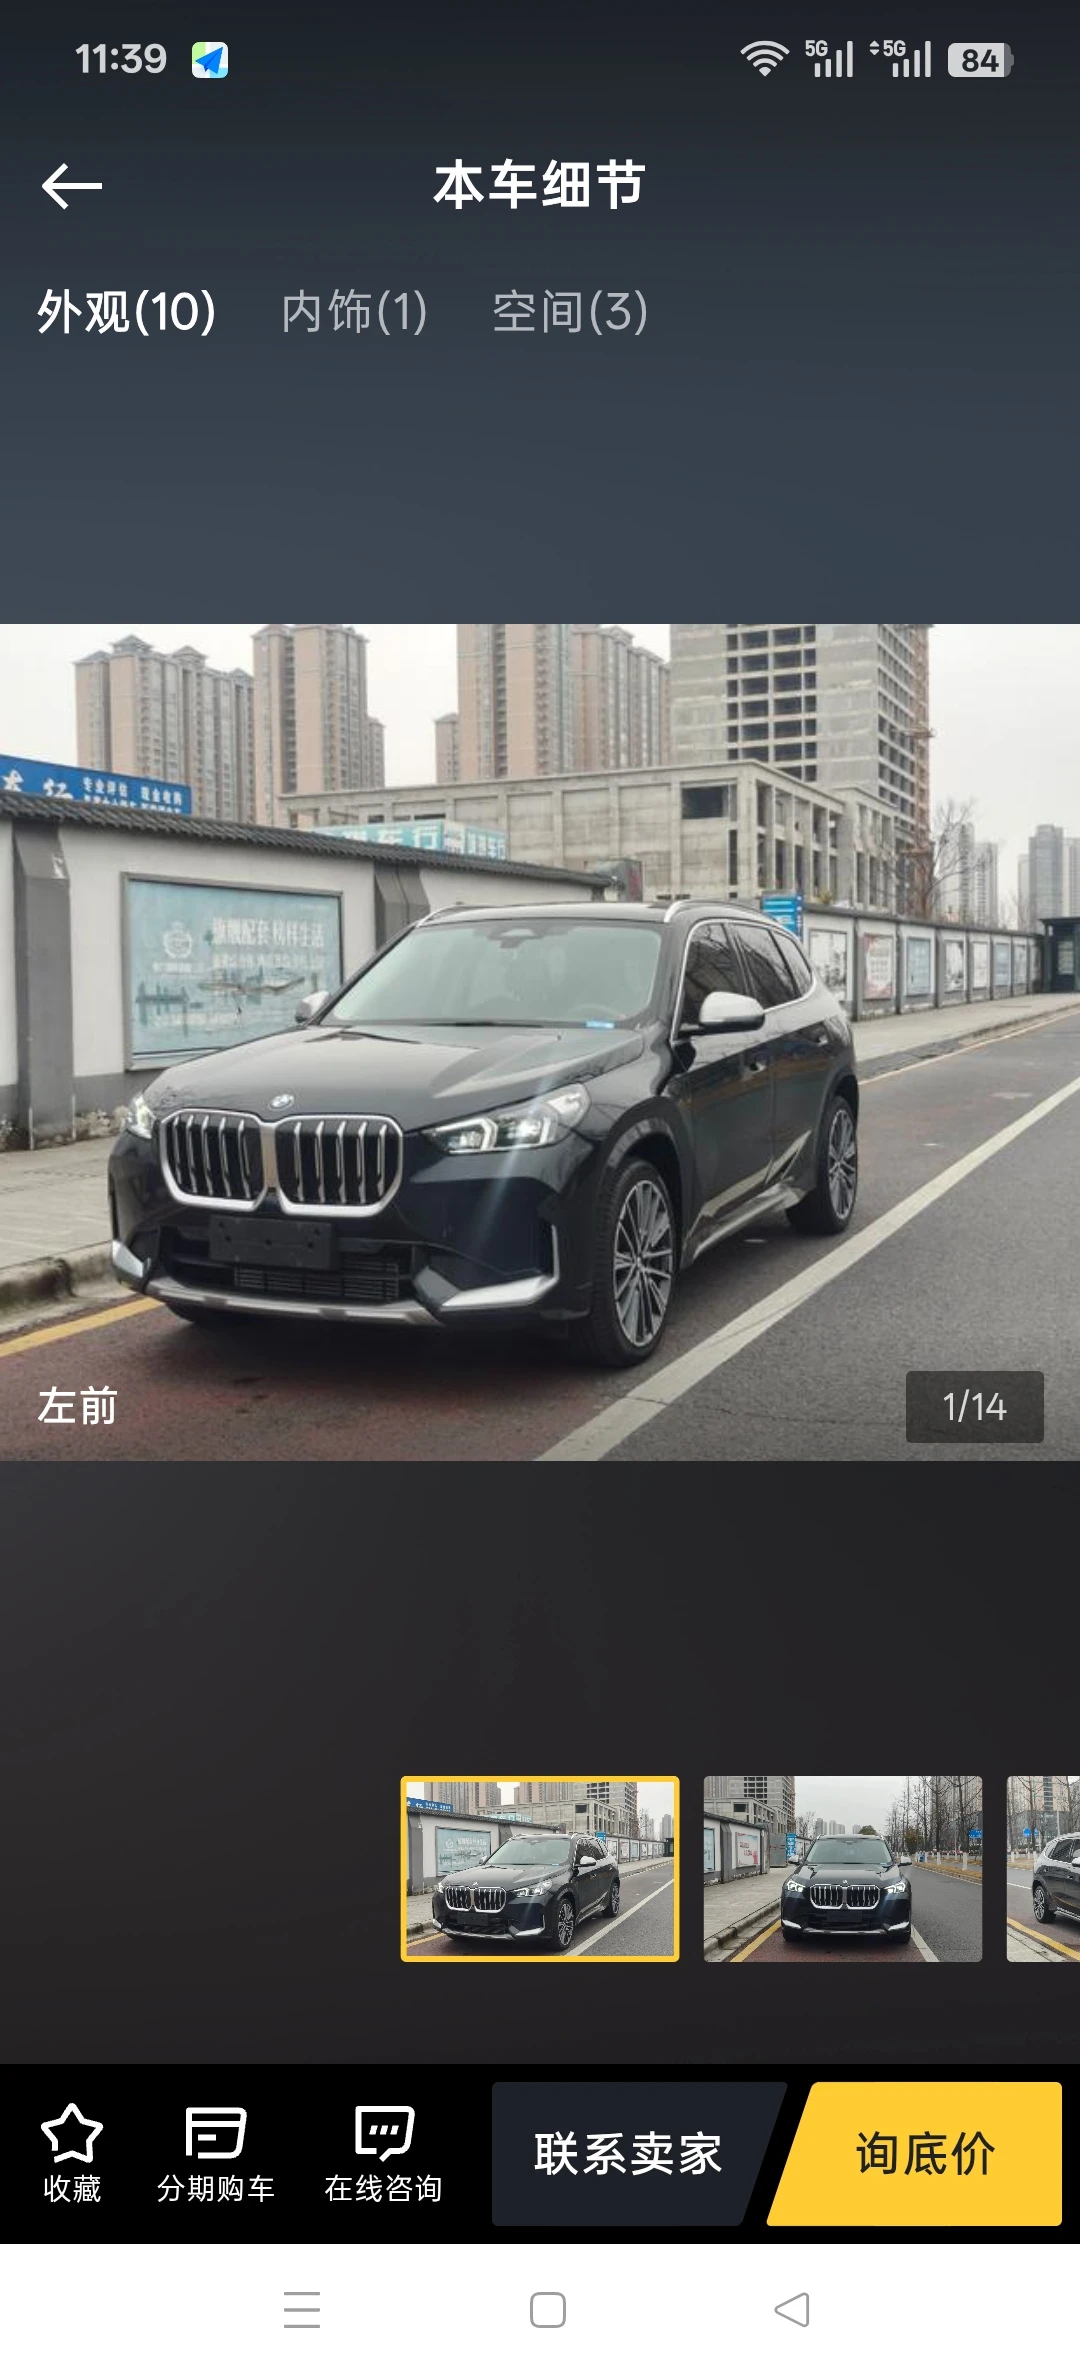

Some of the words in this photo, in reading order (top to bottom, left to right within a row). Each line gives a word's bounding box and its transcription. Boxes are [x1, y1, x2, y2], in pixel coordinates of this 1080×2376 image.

[76, 43, 167, 73] 11:39
[805, 40, 828, 56] 5G
[883, 40, 906, 56] 5G
[962, 49, 999, 72] 84
[433, 158, 646, 209] 本车细节
[36, 288, 215, 337] 外观(10)
[282, 288, 428, 336] 内饰(1)
[493, 288, 647, 336] 空间(3)
[37, 1384, 118, 1426] 左前
[943, 1388, 1008, 1423] 1/14
[533, 2130, 723, 2176] 联系卖家
[855, 2130, 996, 2176] 询底价
[43, 2173, 102, 2204] 收藏
[156, 2173, 275, 2204] 分期购车
[324, 2173, 442, 2204] 在线咨询
